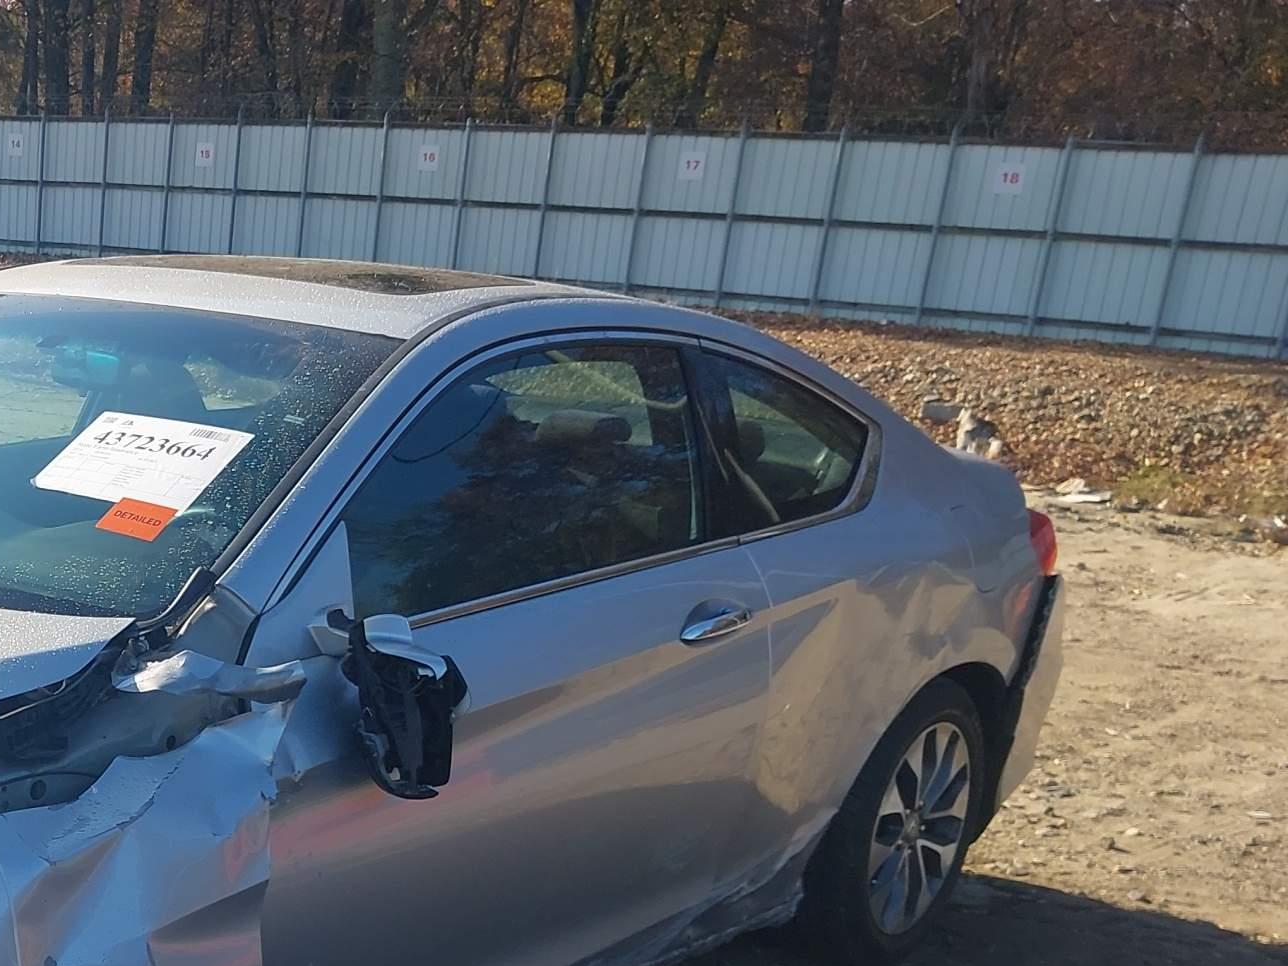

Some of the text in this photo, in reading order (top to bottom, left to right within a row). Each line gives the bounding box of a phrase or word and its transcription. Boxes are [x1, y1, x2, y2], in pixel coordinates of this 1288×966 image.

[11, 139, 20, 148] 14
[200, 150, 210, 159] 15
[423, 152, 435, 162] 16
[685, 160, 701, 170] 17
[1003, 172, 1019, 183] 18
[93, 430, 217, 461] 43723664
[114, 510, 161, 527] DETAILED
